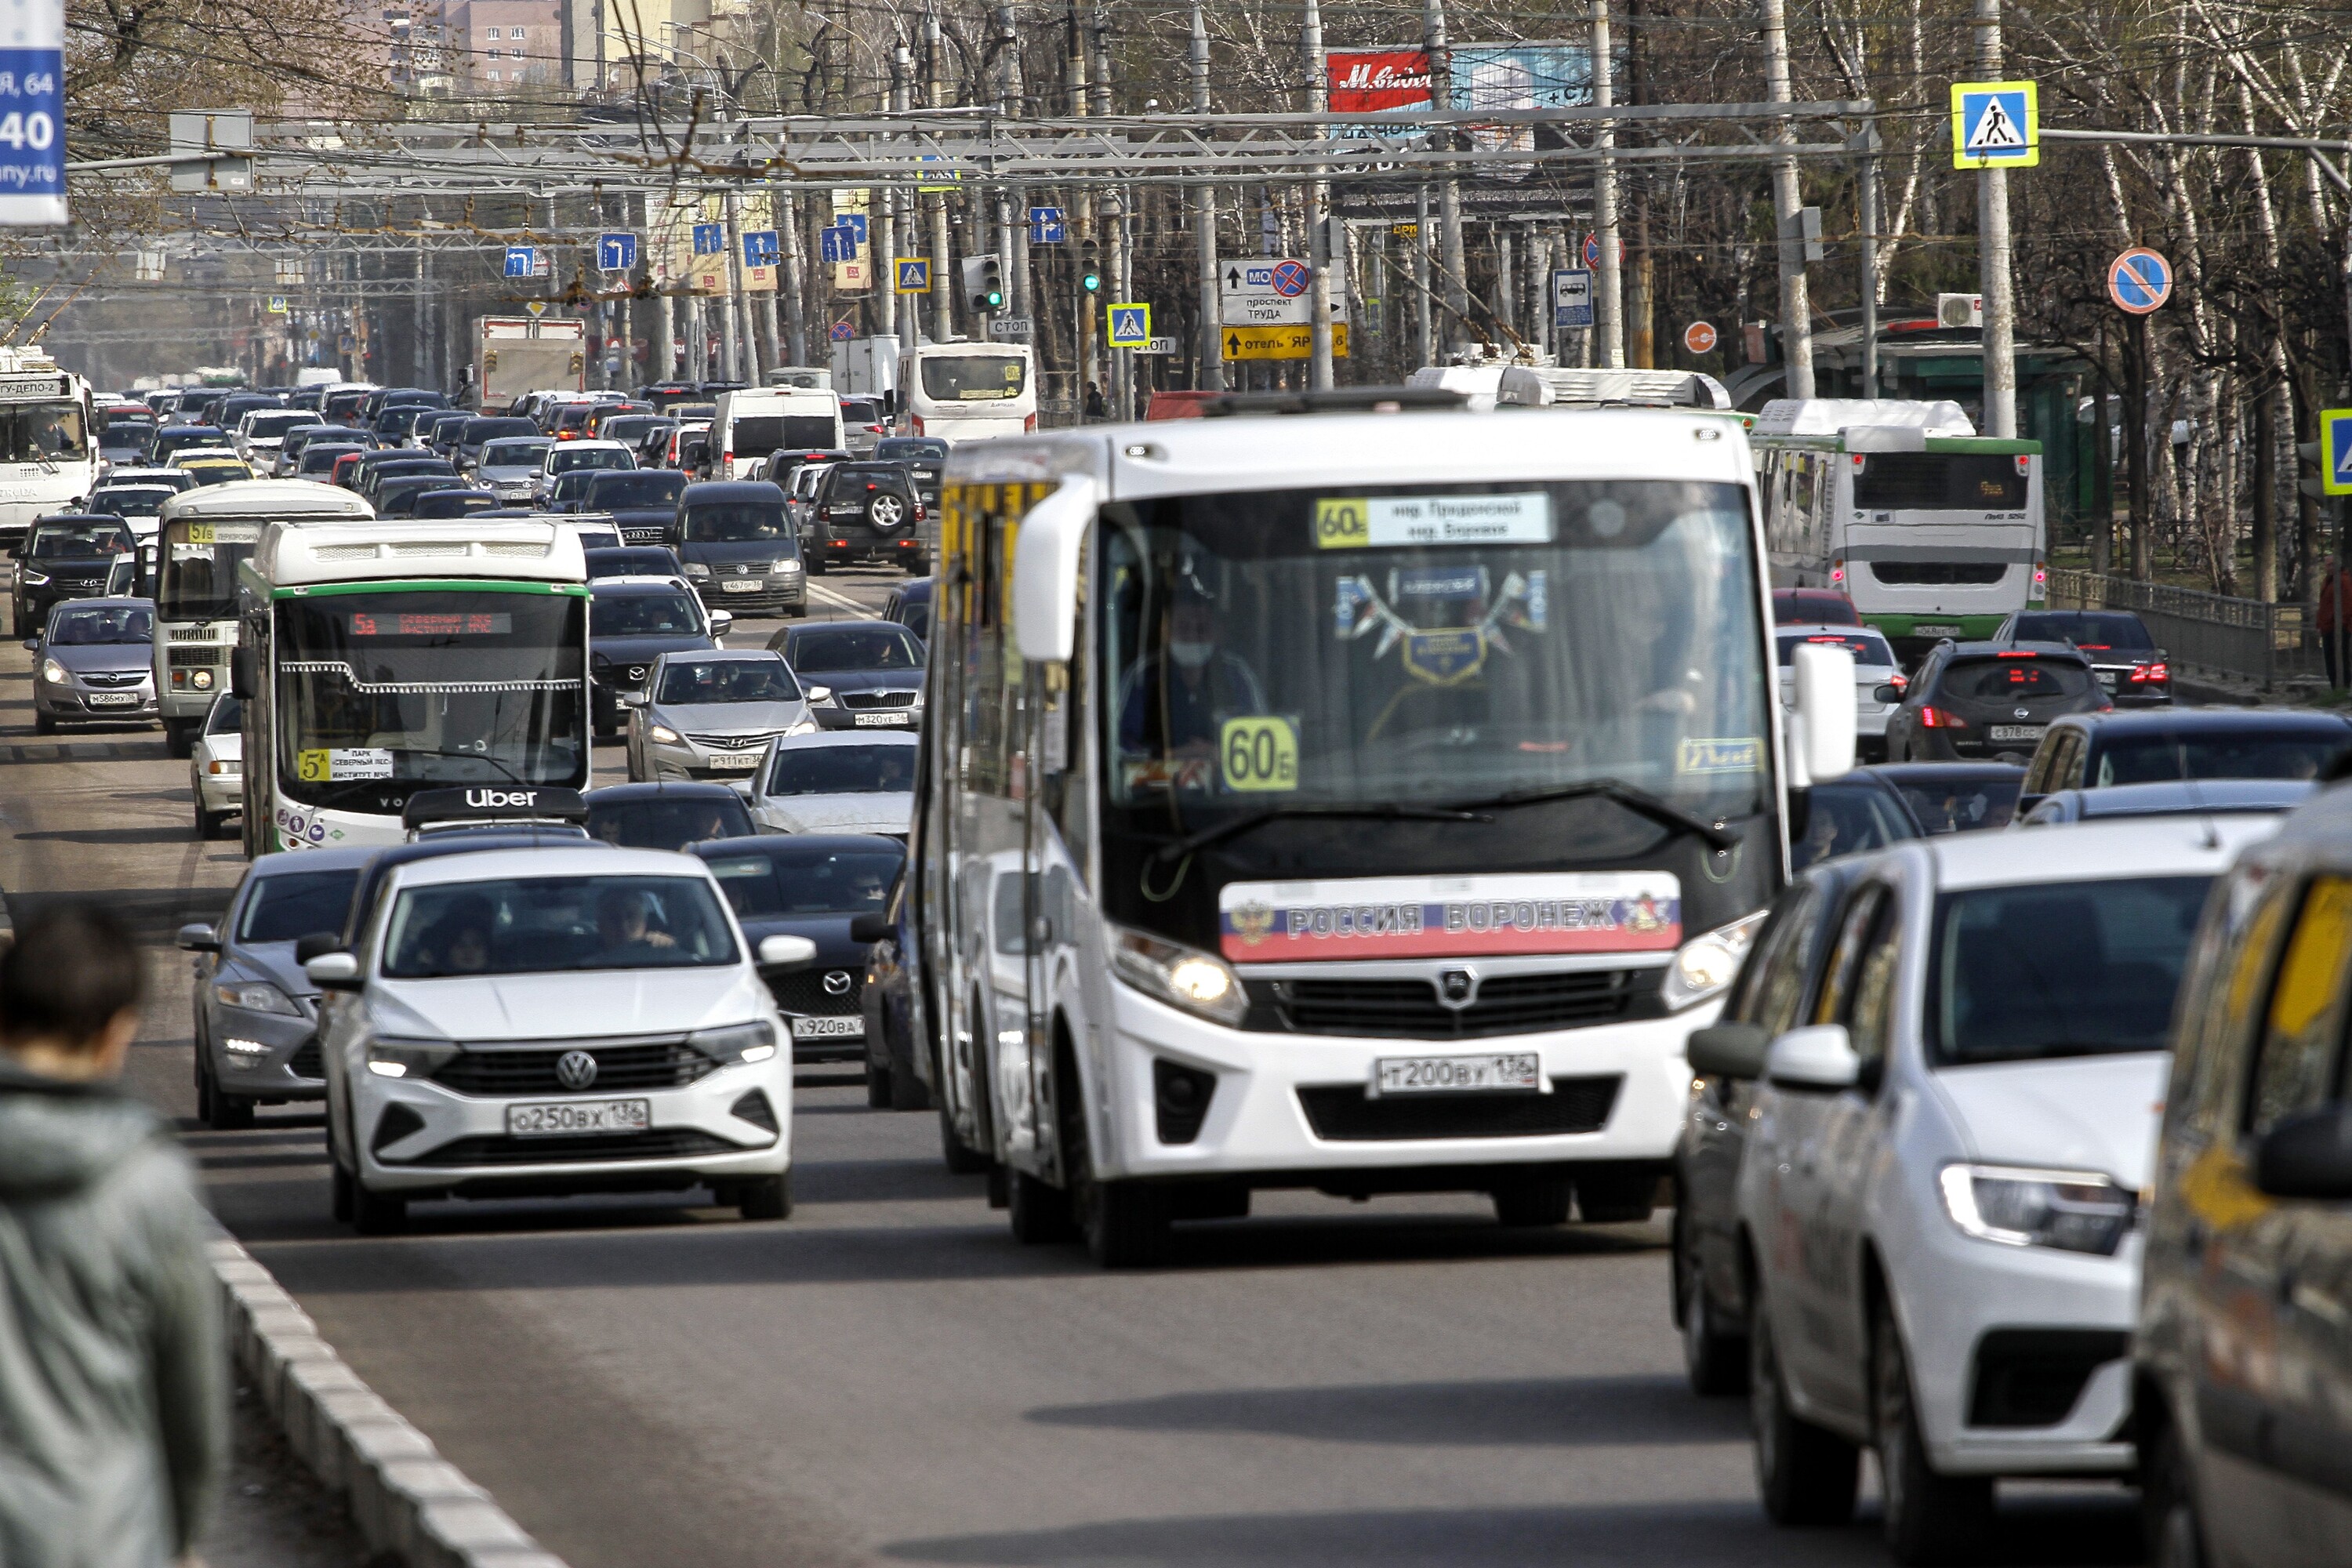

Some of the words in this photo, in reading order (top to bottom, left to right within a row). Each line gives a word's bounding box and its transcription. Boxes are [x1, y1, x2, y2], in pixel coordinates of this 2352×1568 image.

[24, 72, 55, 96] 64
[0, 111, 54, 151] 40
[0, 164, 57, 189] ny.ru
[1247, 299, 1292, 307] проспект
[1248, 310, 1281, 320] ТРУДА
[995, 321, 1028, 332] СТОП
[1245, 339, 1283, 350] отель
[466, 789, 537, 808] Uber
[1287, 902, 1424, 939] РОССИЯ
[1443, 898, 1617, 935] ВОРОНЕЖ
